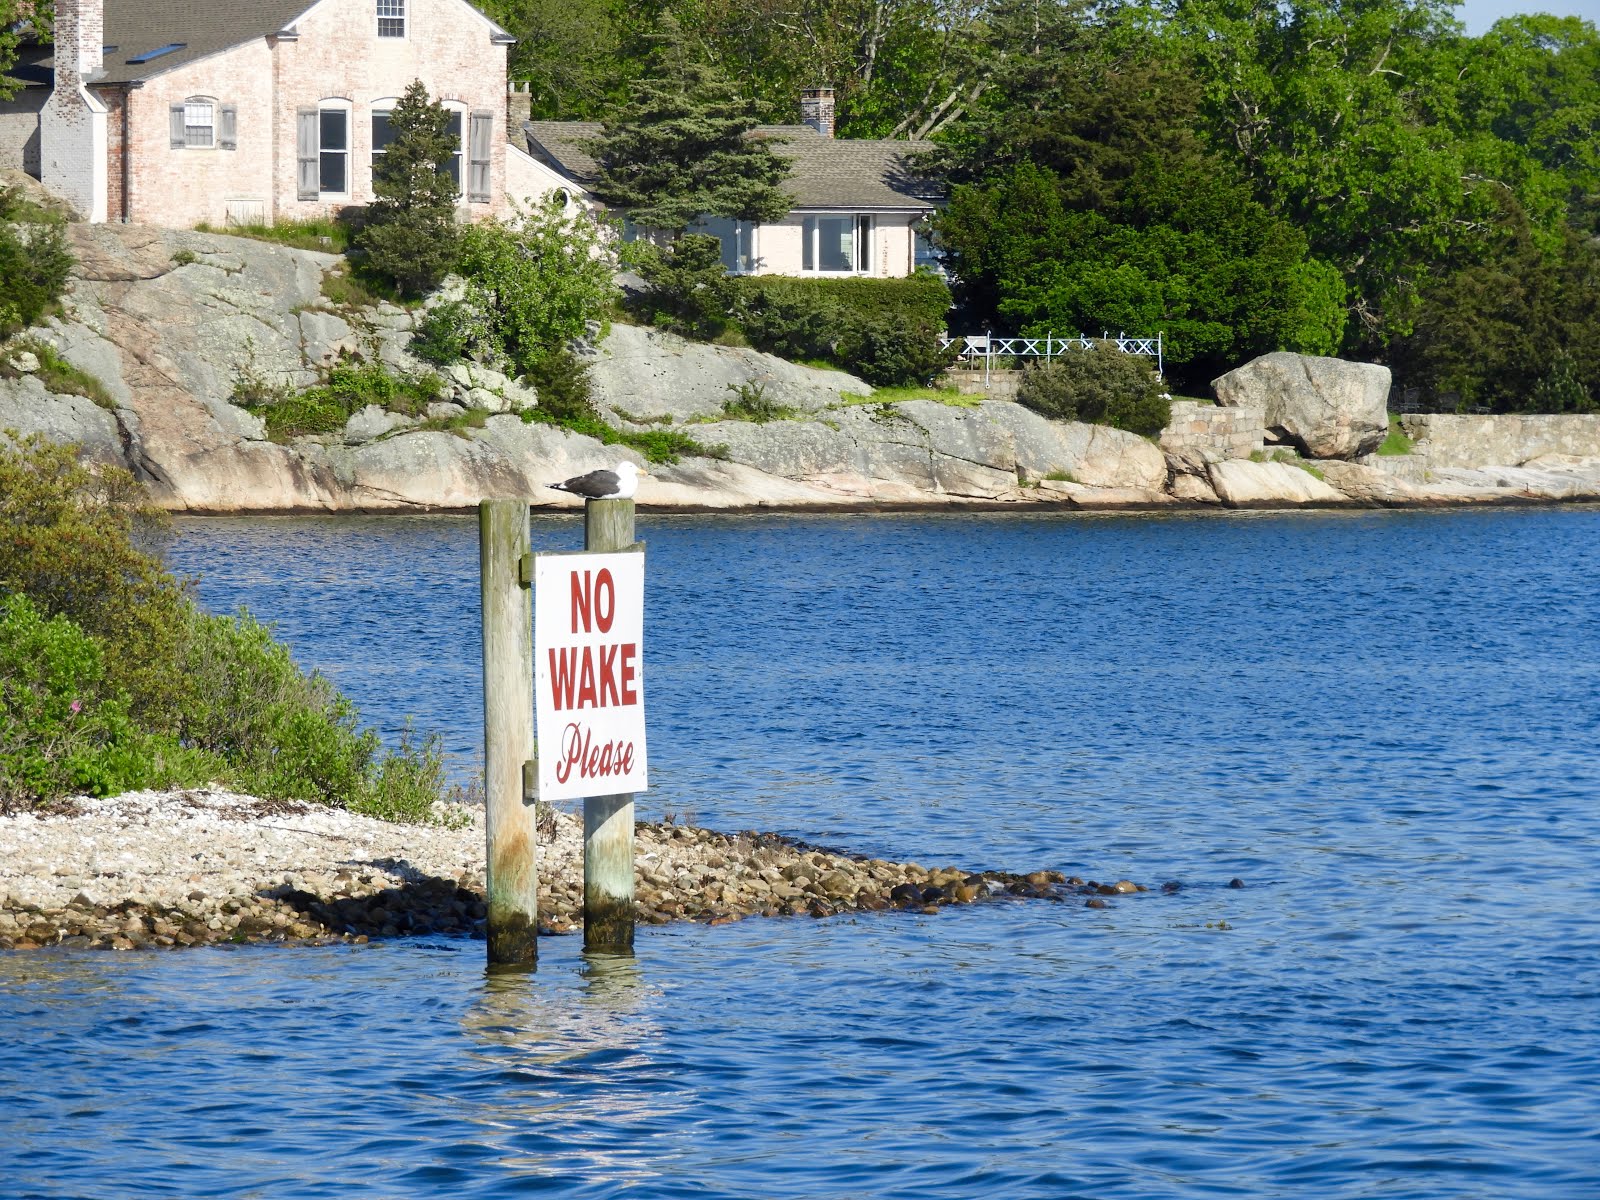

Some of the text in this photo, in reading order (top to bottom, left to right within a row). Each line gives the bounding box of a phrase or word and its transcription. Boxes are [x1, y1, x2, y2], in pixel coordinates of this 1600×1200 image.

[571, 568, 615, 634] NO
[548, 643, 637, 711] WAKE
[556, 721, 634, 784] Please
